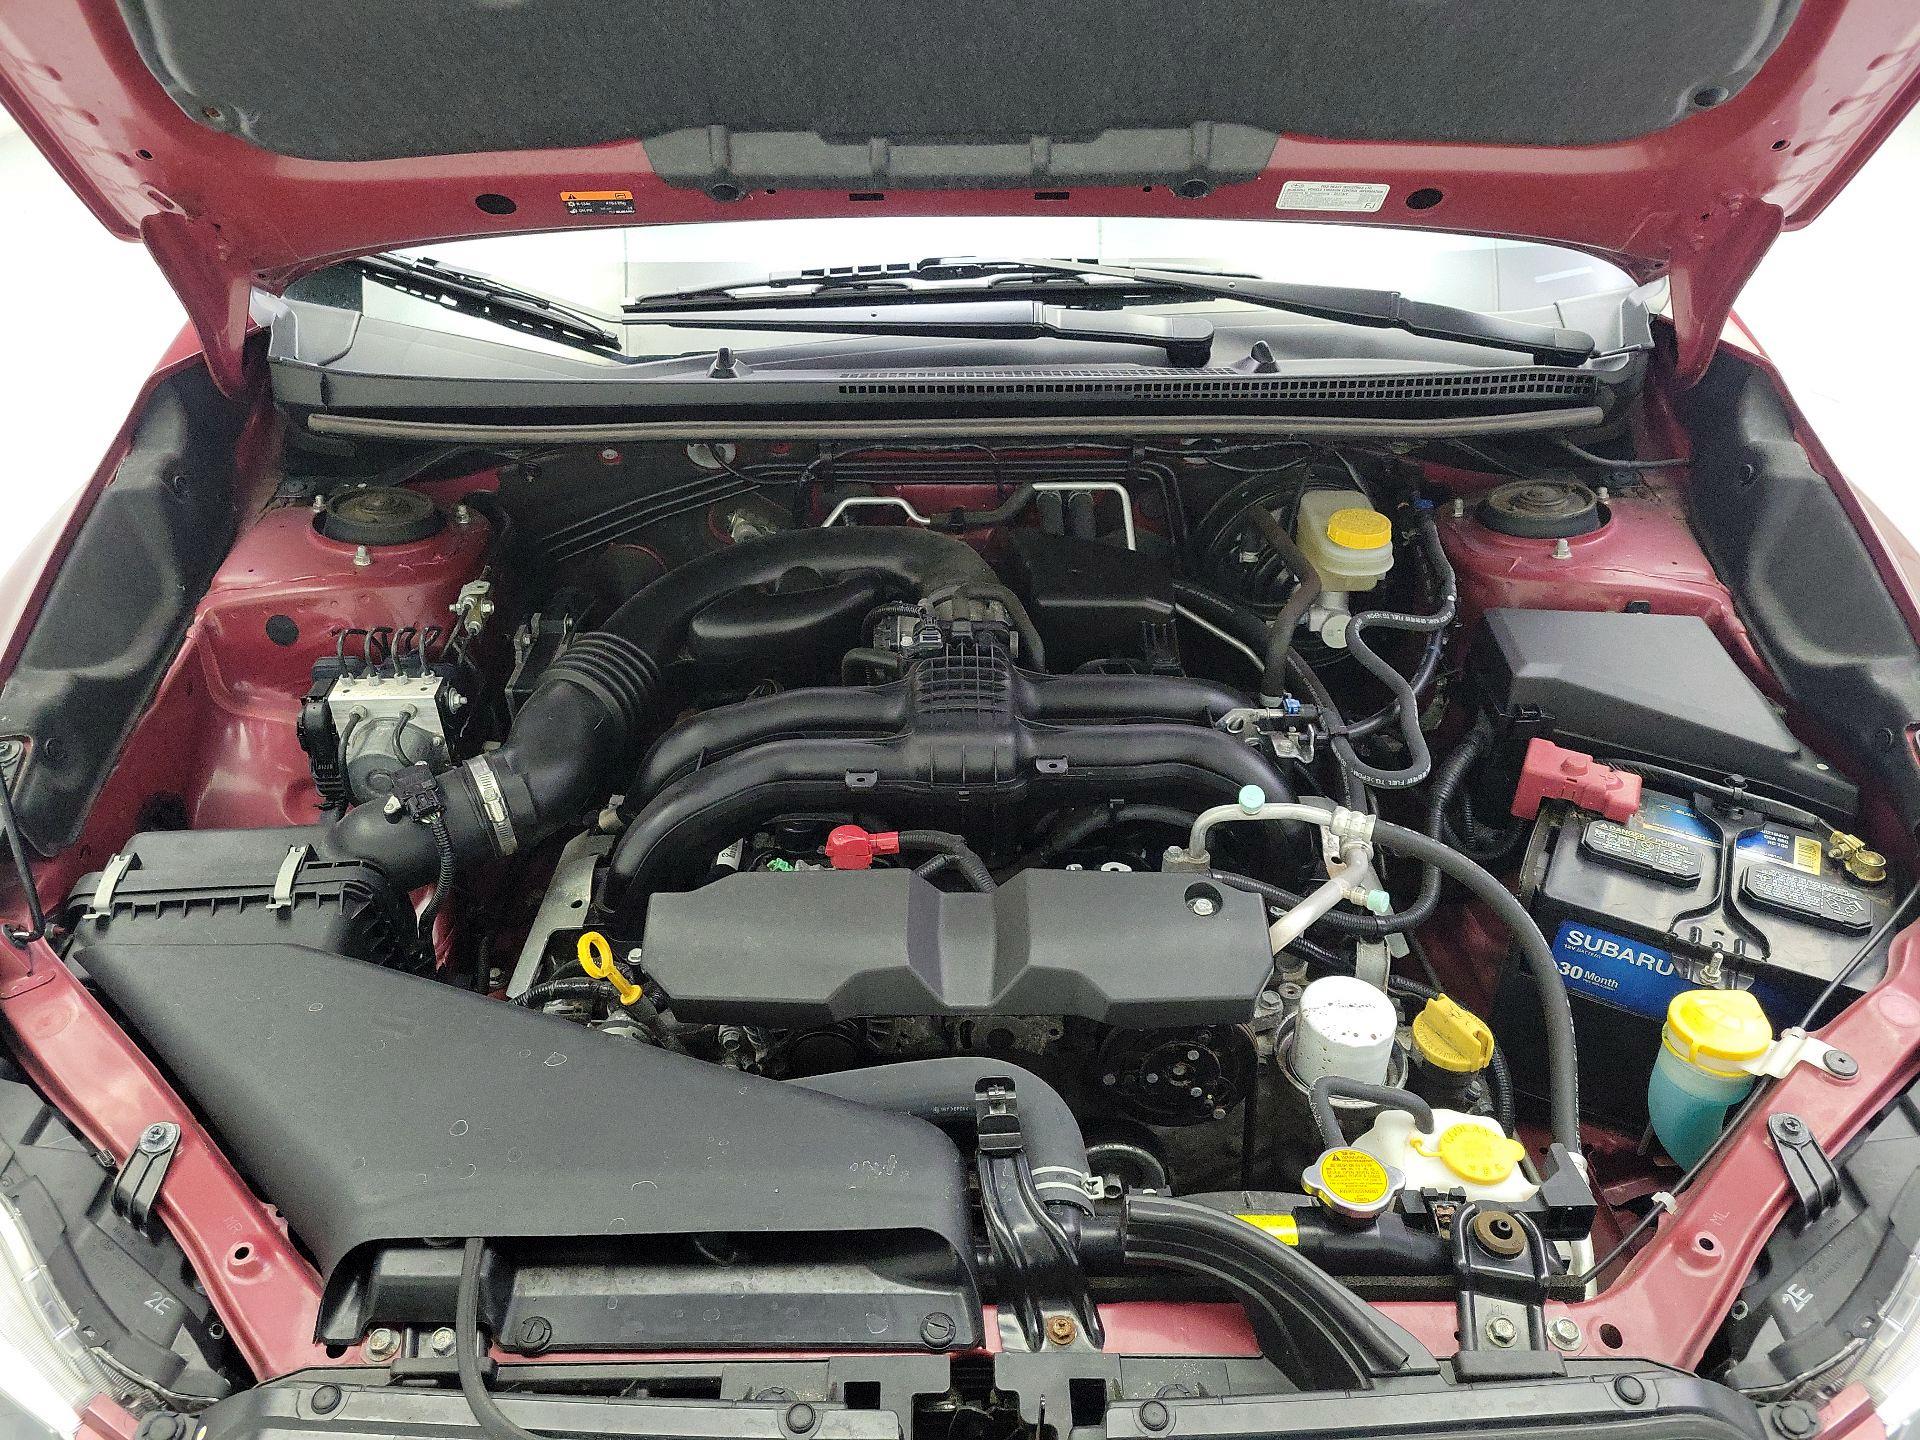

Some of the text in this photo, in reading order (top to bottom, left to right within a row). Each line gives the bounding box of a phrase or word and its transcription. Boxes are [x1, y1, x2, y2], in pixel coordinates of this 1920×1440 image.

[1566, 930, 1675, 976] SUBARU
[1559, 961, 1584, 980] 30
[1584, 970, 1619, 989] Month
[143, 1291, 176, 1316] 2E
[1782, 1283, 1814, 1313] 2E
